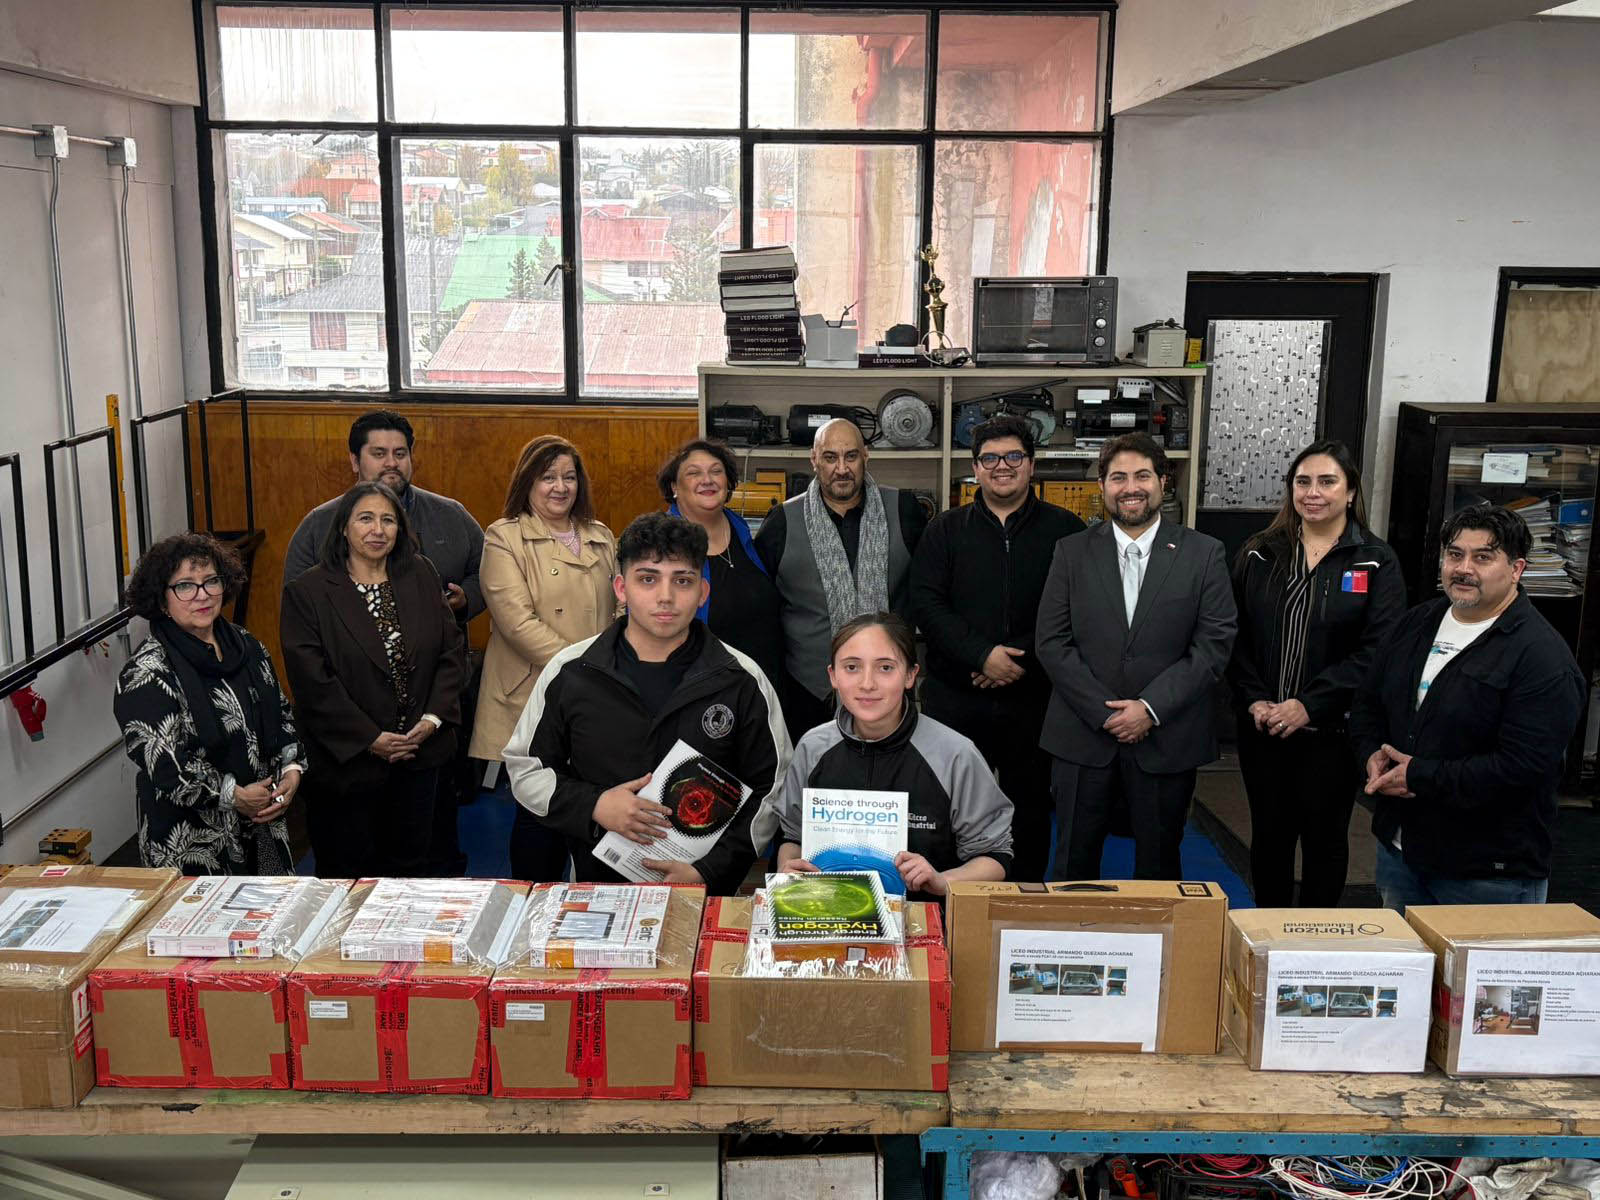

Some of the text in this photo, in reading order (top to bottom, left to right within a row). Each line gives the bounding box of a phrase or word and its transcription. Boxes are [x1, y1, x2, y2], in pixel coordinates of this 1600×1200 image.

[812, 796, 899, 810] Science through
[812, 806, 899, 826] Hydrogen
[832, 826, 853, 835] Energy
[779, 921, 878, 931] Hydrogen
[1283, 927, 1354, 936] Horizon
